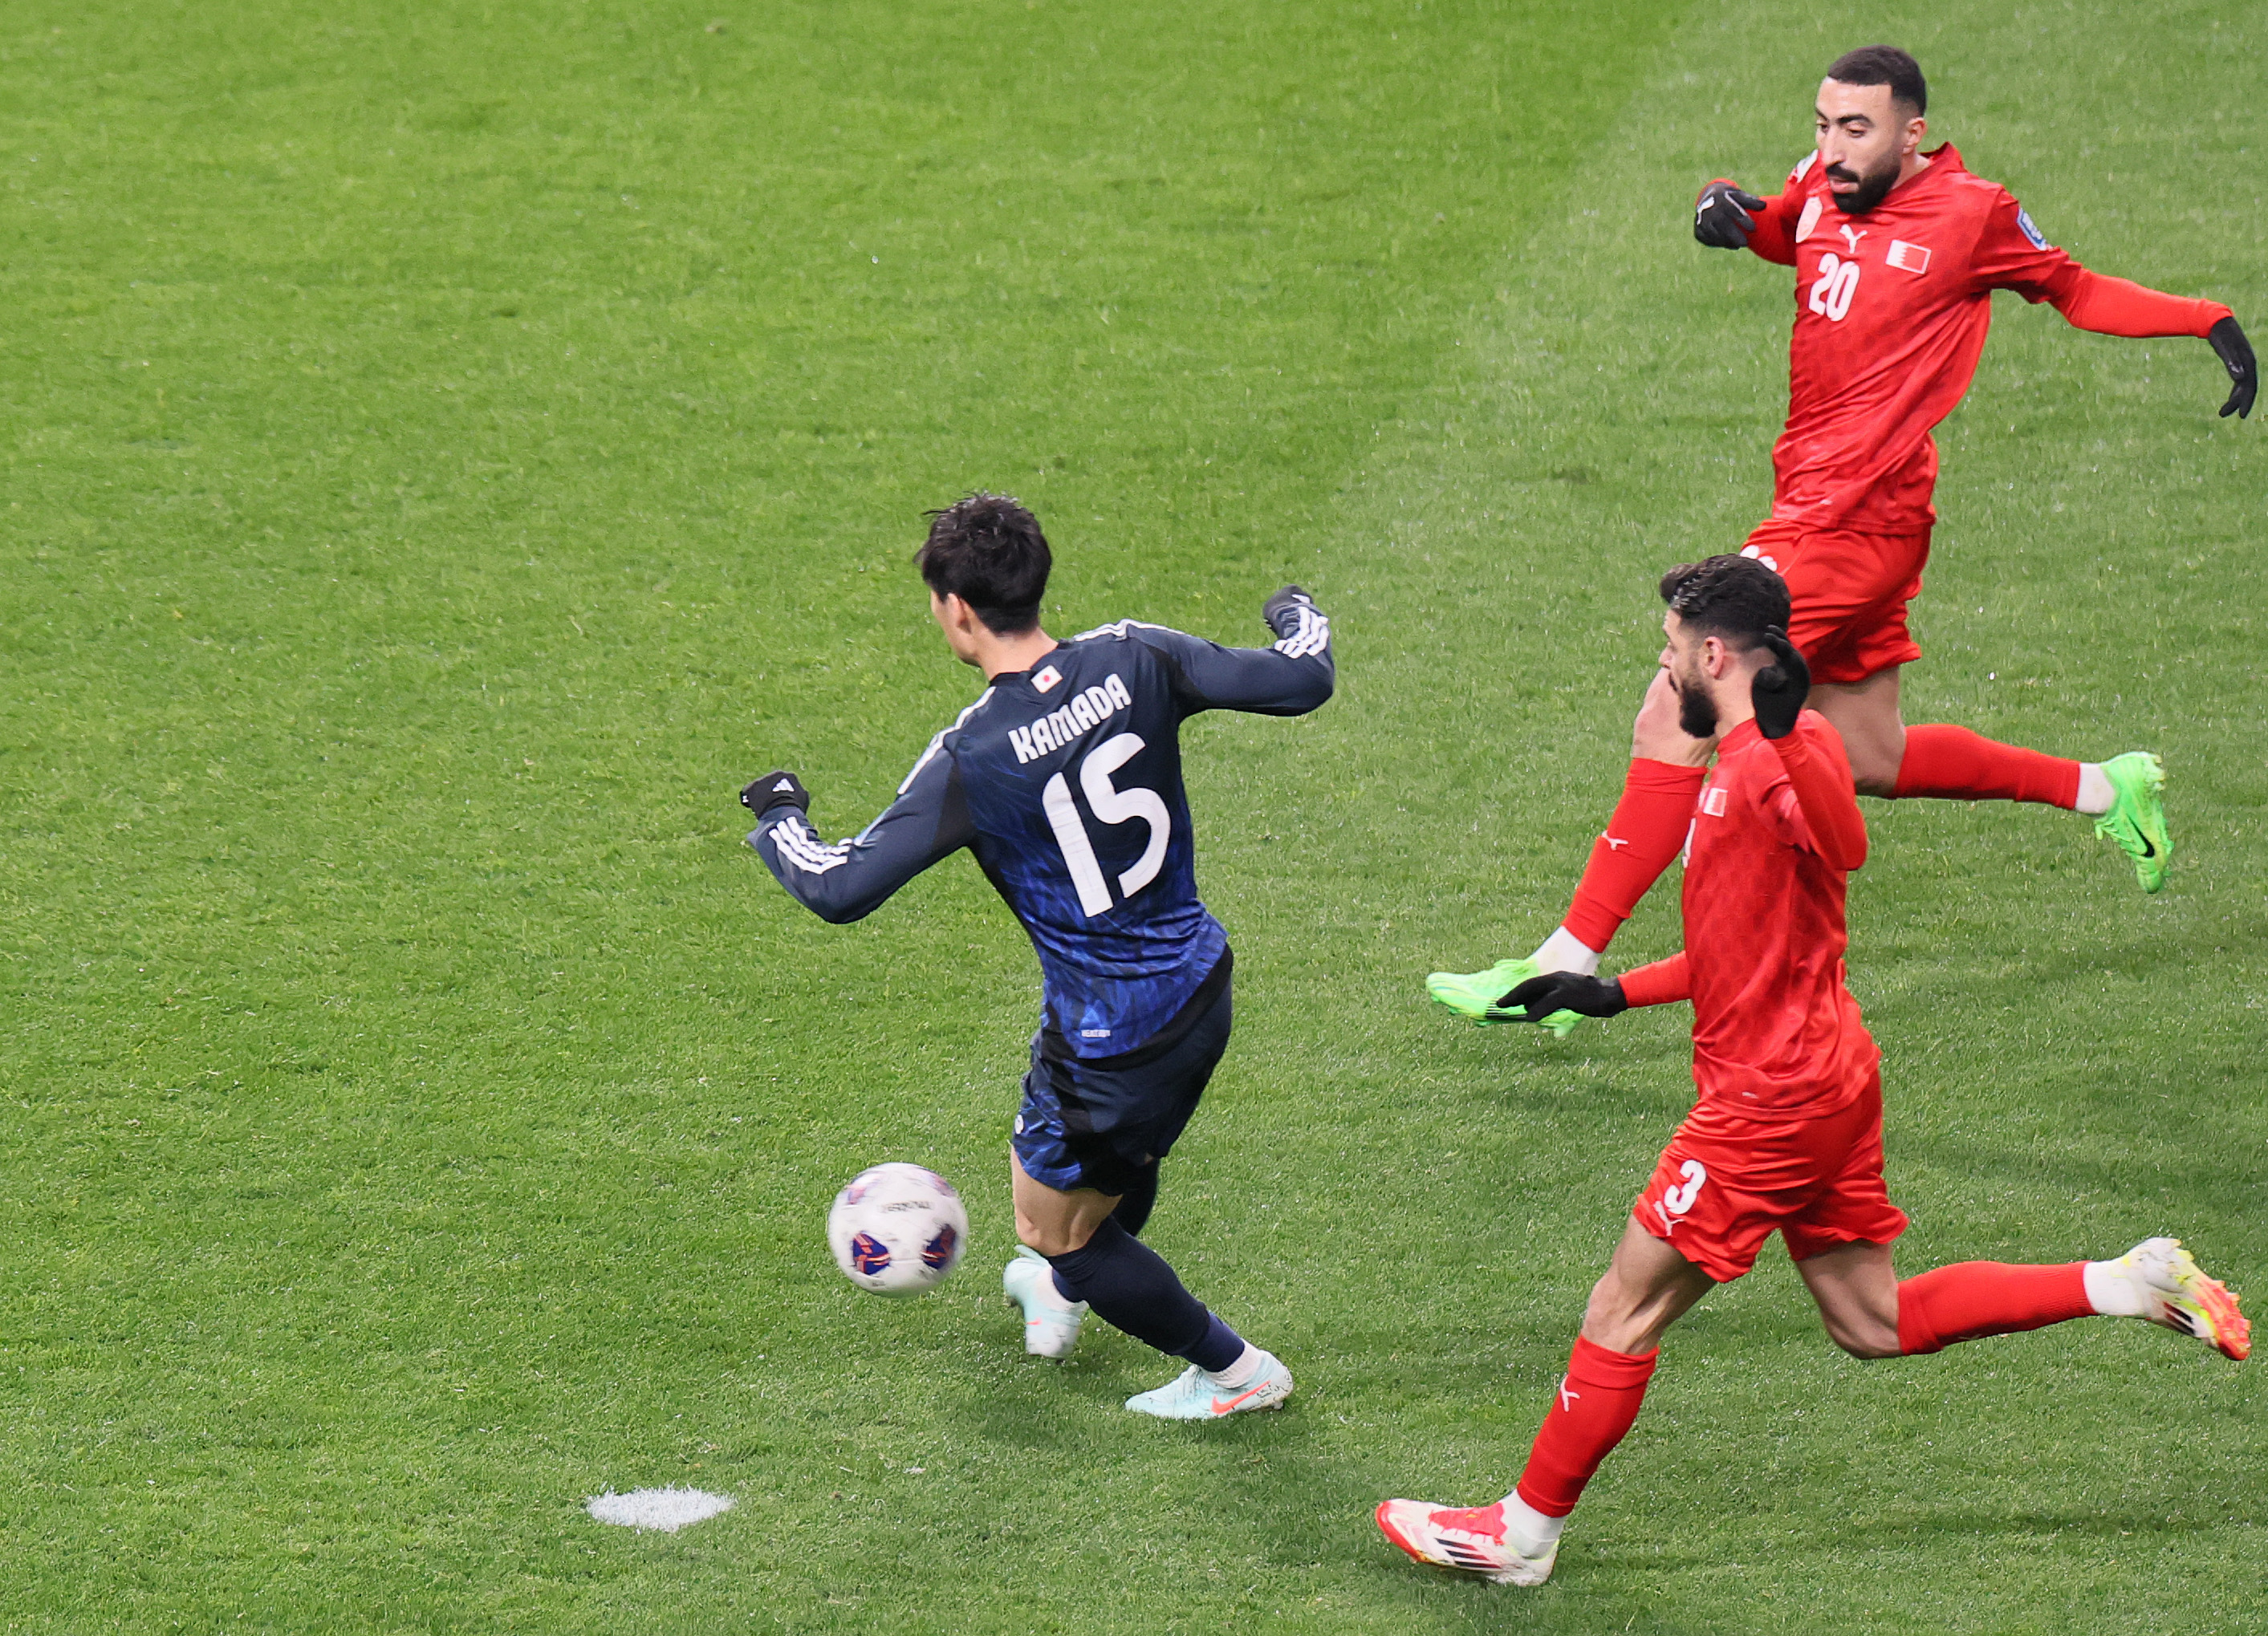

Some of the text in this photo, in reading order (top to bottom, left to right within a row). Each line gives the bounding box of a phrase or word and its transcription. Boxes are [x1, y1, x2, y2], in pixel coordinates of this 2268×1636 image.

[1808, 253, 1860, 322] 20
[1008, 673, 1132, 764] KAMADA
[1042, 733, 1171, 918] 15
[1664, 1159, 1707, 1215] 3
